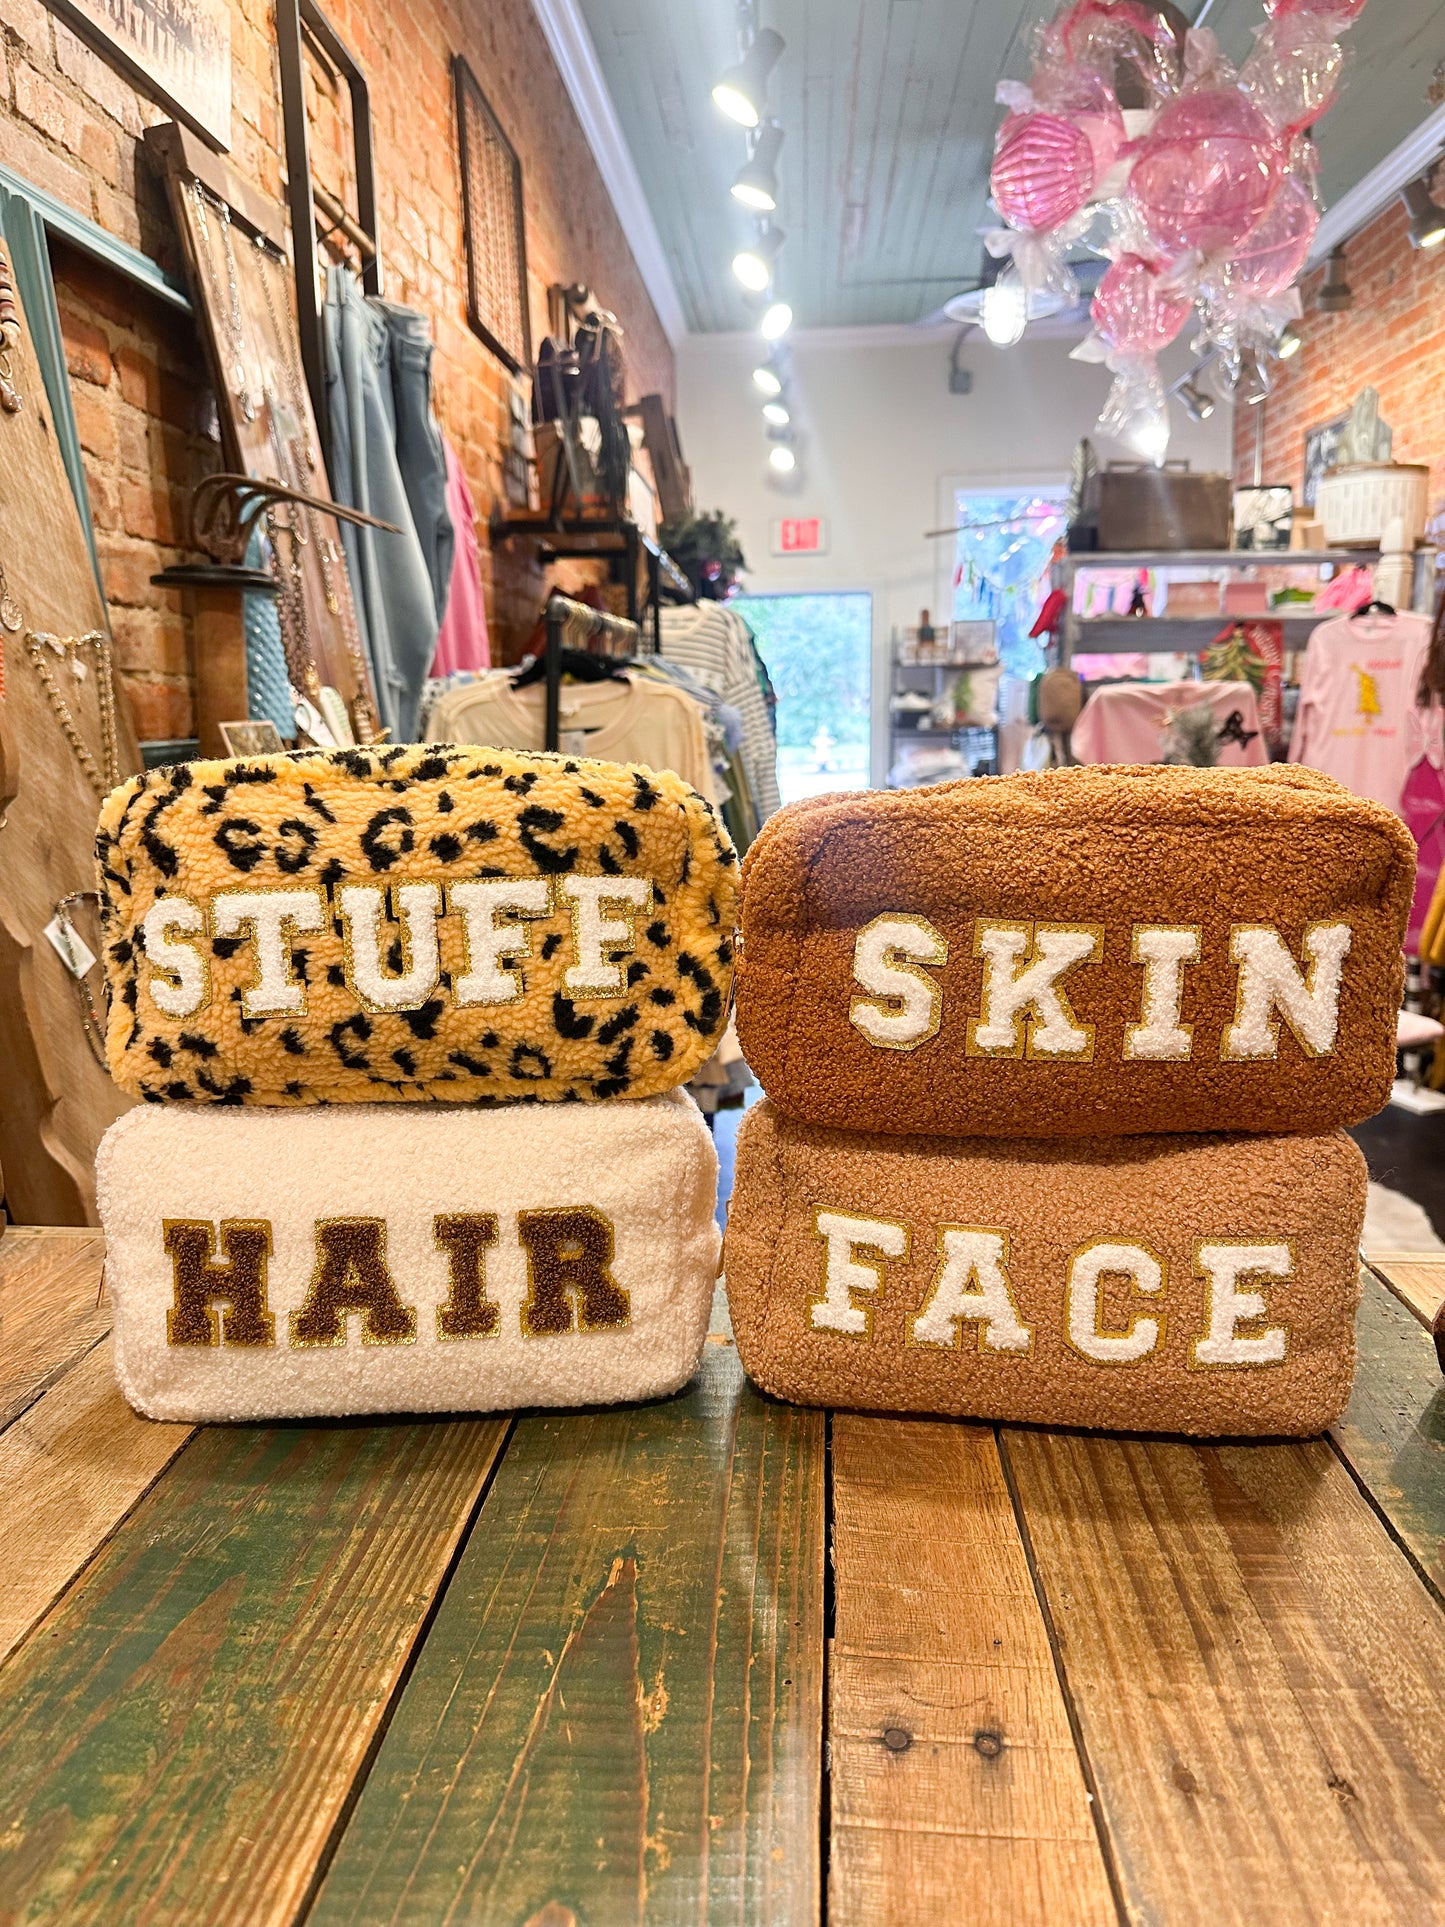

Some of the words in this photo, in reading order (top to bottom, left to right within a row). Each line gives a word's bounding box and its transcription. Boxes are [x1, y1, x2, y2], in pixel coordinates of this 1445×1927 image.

[142, 874, 655, 1021] STUFF
[849, 911, 1352, 1062] SKIN
[162, 1204, 632, 1349] HAIR
[806, 1203, 1296, 1370] FACE
